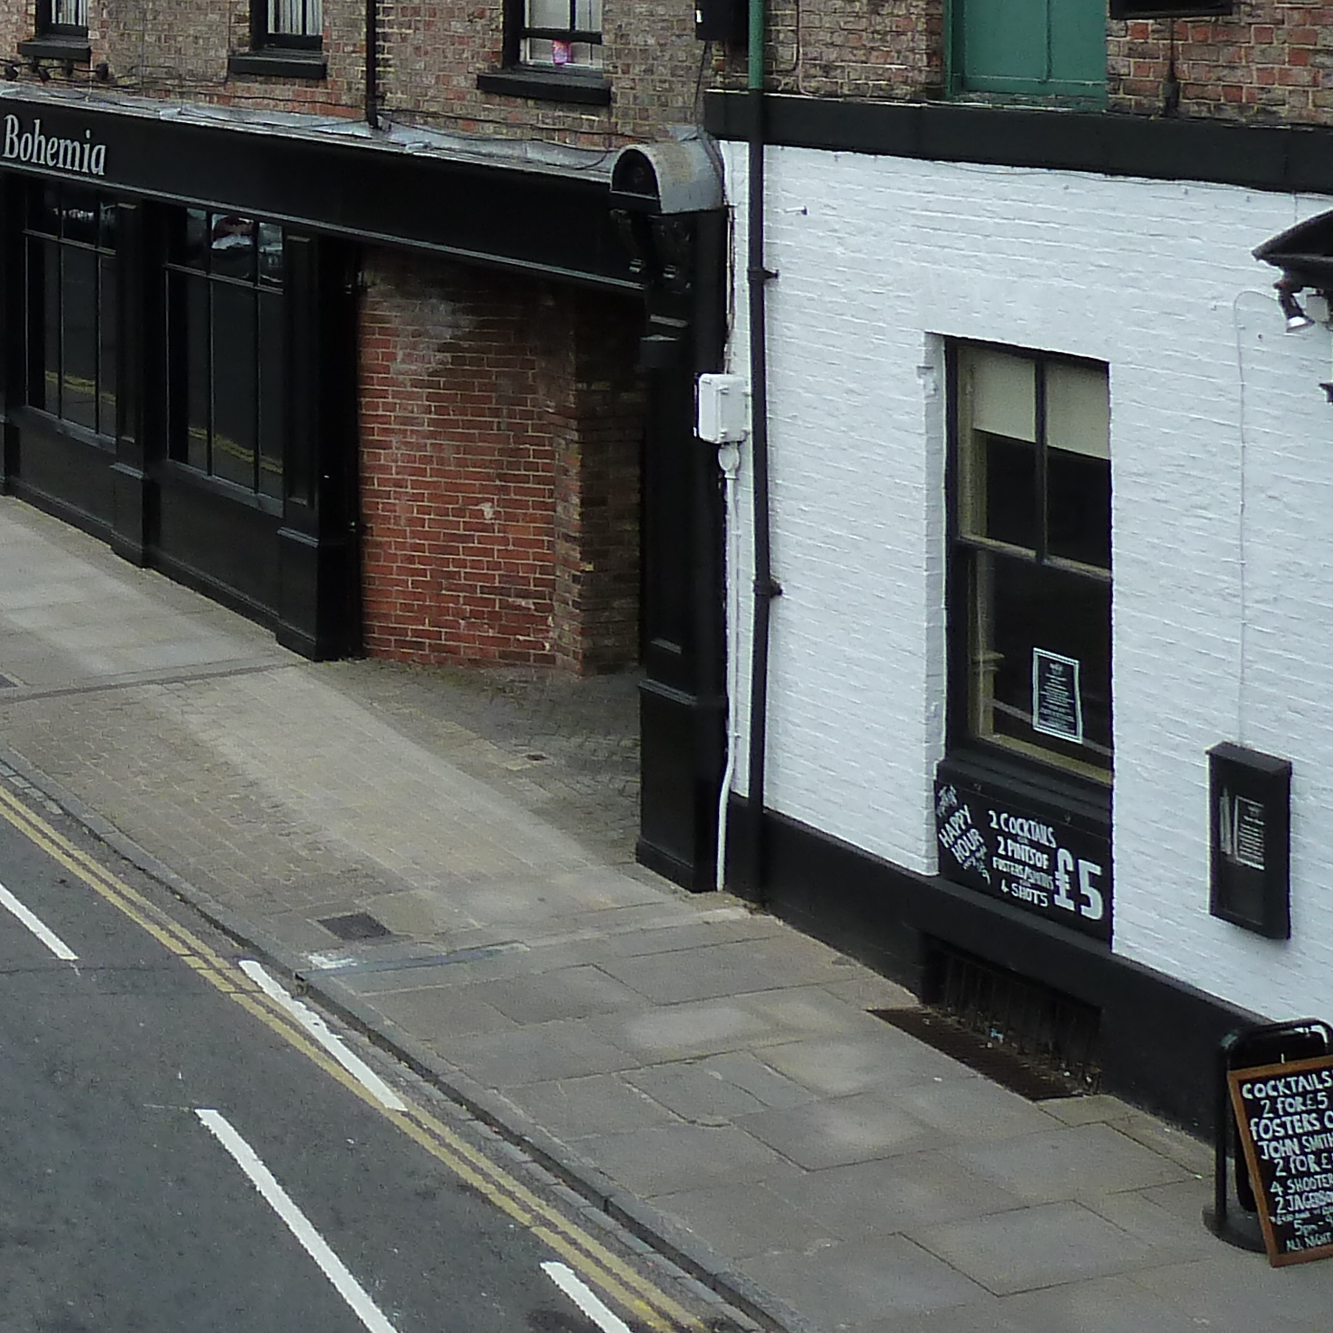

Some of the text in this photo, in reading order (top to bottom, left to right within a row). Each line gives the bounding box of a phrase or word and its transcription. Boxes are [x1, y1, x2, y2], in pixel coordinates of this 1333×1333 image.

[1, 114, 107, 176] Bohemia
[938, 804, 972, 849] HAPPY
[988, 810, 1057, 848] 2 COCKTAILS
[951, 828, 984, 864] HOUR
[997, 835, 1006, 855] 2
[1007, 839, 1036, 865] PINTS
[1035, 854, 1049, 869] OF
[1011, 883, 1049, 908] SHOTS
[1053, 848, 1104, 921] £5
[1260, 1099, 1275, 1118] 2
[1257, 1137, 1300, 1160] JOHN
[1274, 1158, 1287, 1177] 2
[1270, 1180, 1284, 1196] 4
[1274, 1196, 1287, 1213] 2
